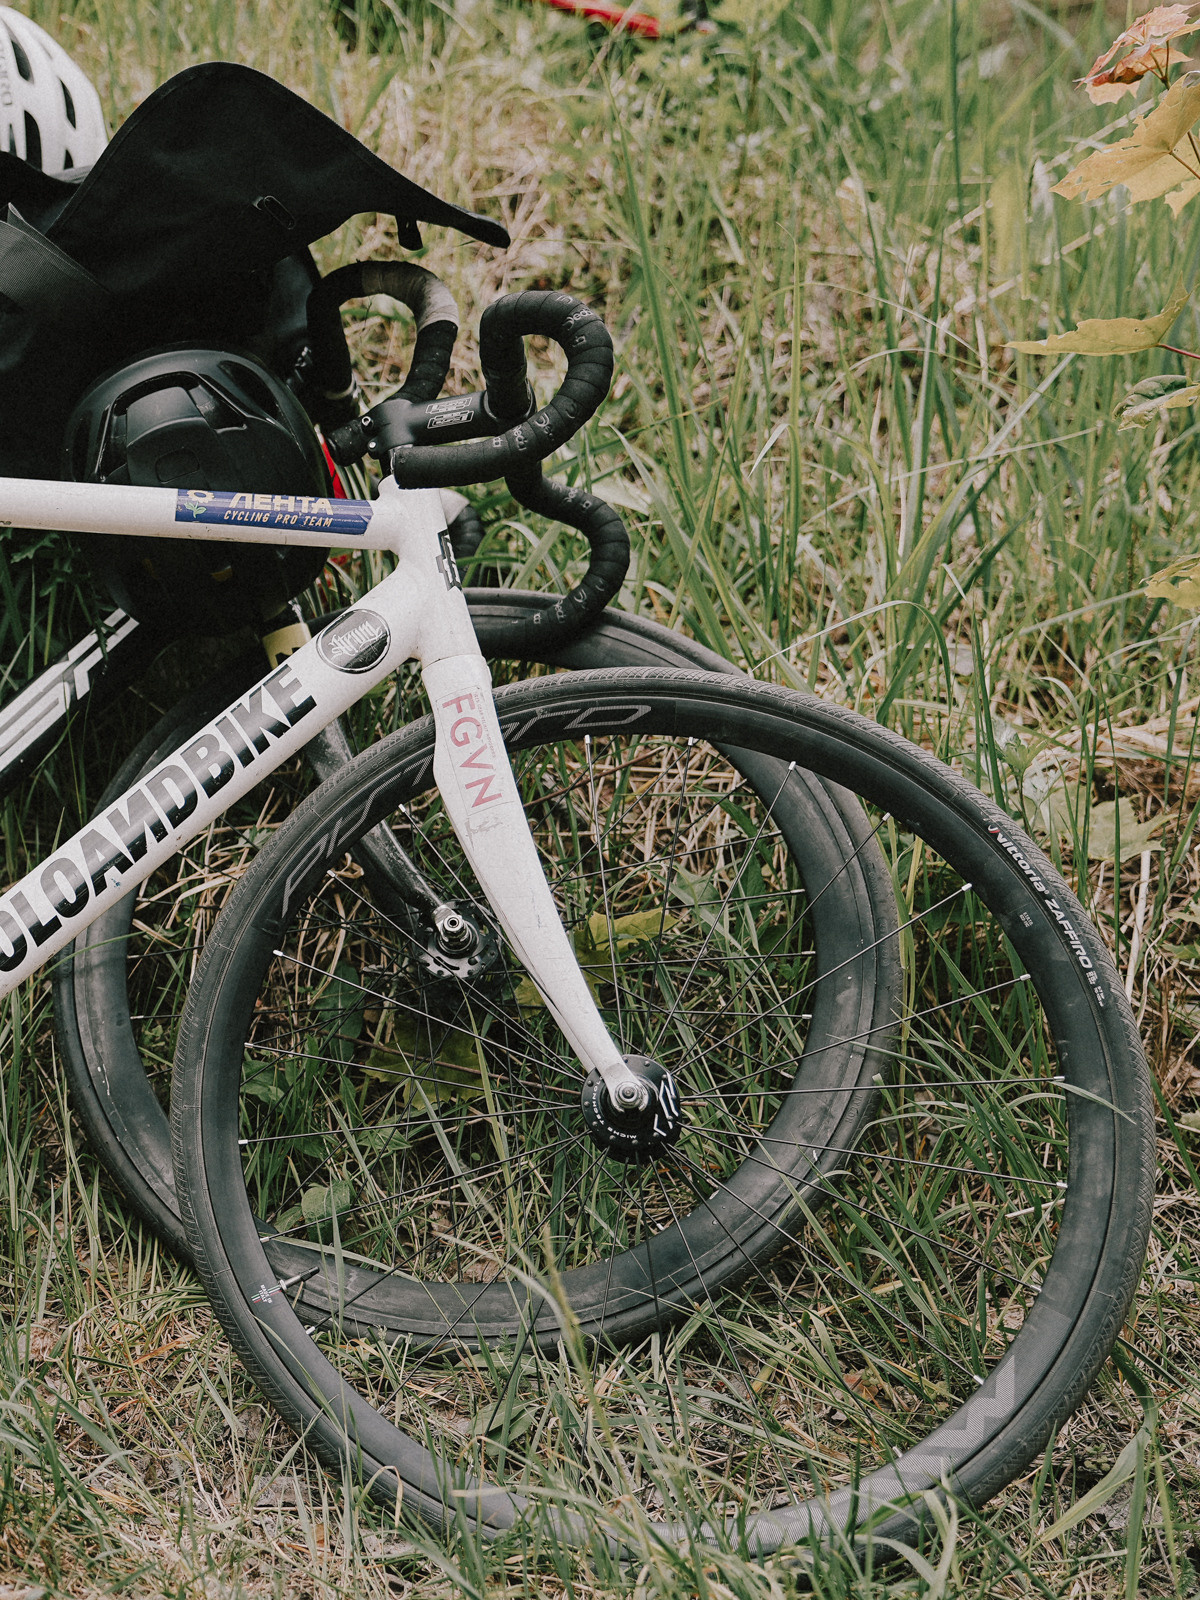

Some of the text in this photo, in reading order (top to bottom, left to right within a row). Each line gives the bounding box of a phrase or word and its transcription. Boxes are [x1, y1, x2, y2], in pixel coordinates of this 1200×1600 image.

[223, 509, 334, 528] CYCLING PRO TEAM
[228, 492, 334, 516] ЛЕНТА
[442, 693, 503, 808] FGVN
[1044, 898, 1093, 969] ZAFFIRO
